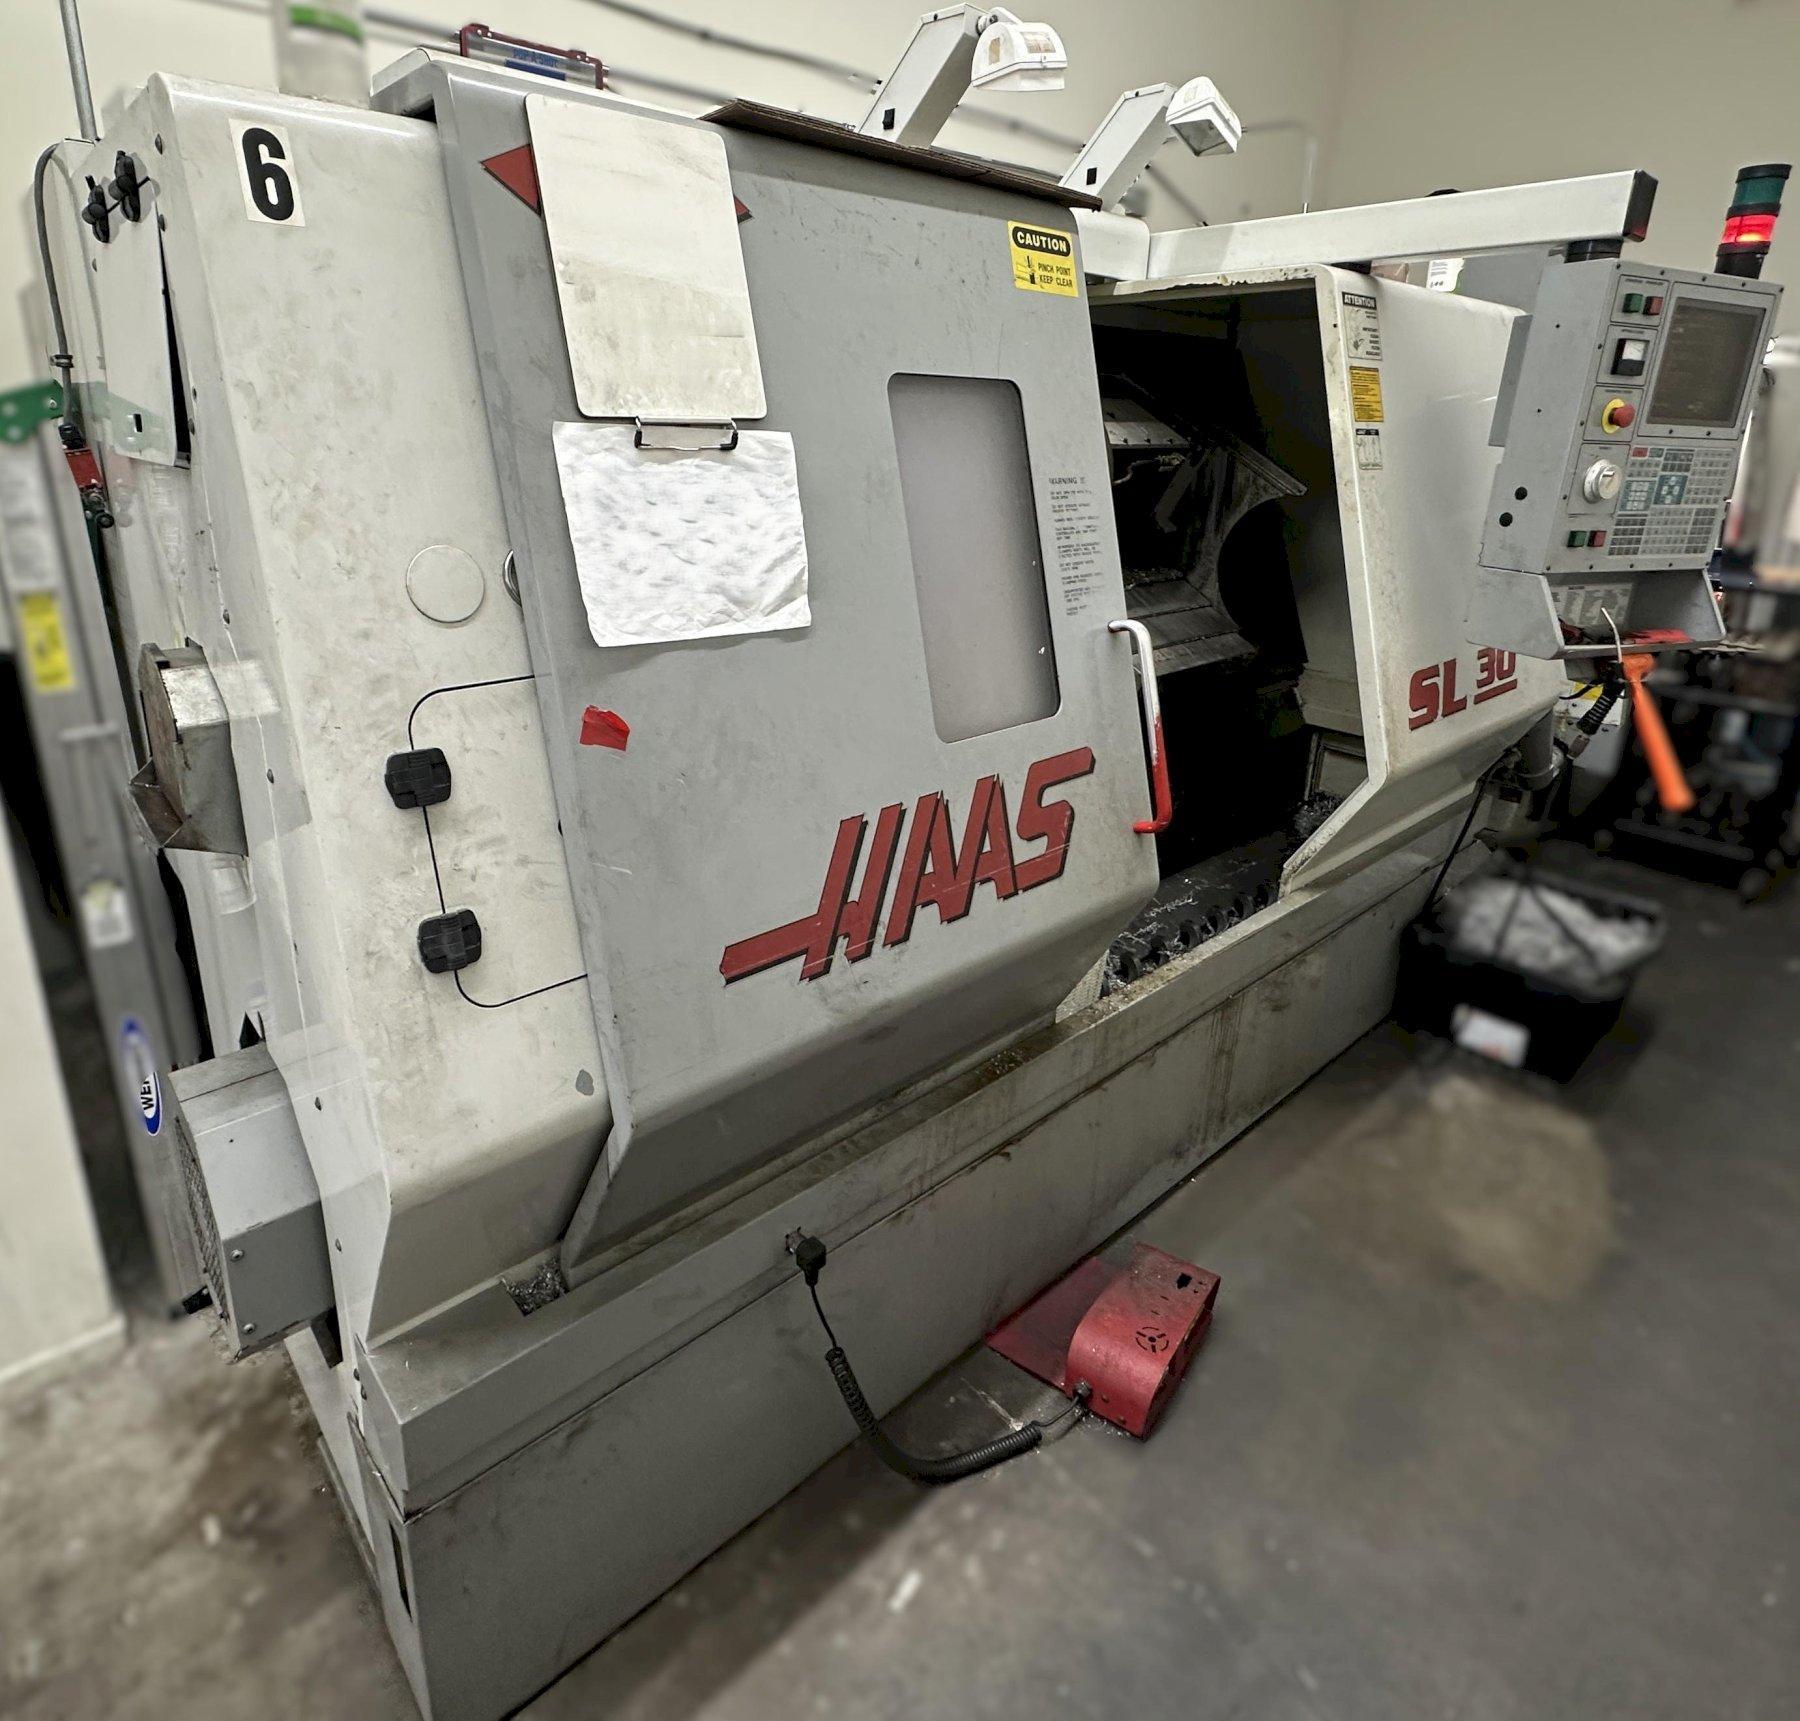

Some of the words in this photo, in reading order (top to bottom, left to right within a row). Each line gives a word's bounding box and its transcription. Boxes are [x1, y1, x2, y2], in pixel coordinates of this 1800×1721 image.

[242, 127, 295, 221] 6
[1016, 231, 1067, 253] CAUTION
[1038, 262, 1055, 273] PINCH
[1056, 265, 1071, 276] POINT
[1039, 274, 1054, 284] KEEP
[1056, 277, 1074, 288] CLEAR
[1409, 658, 1467, 732] SL
[1477, 647, 1517, 690] 30
[719, 746, 1096, 987] HAAS
